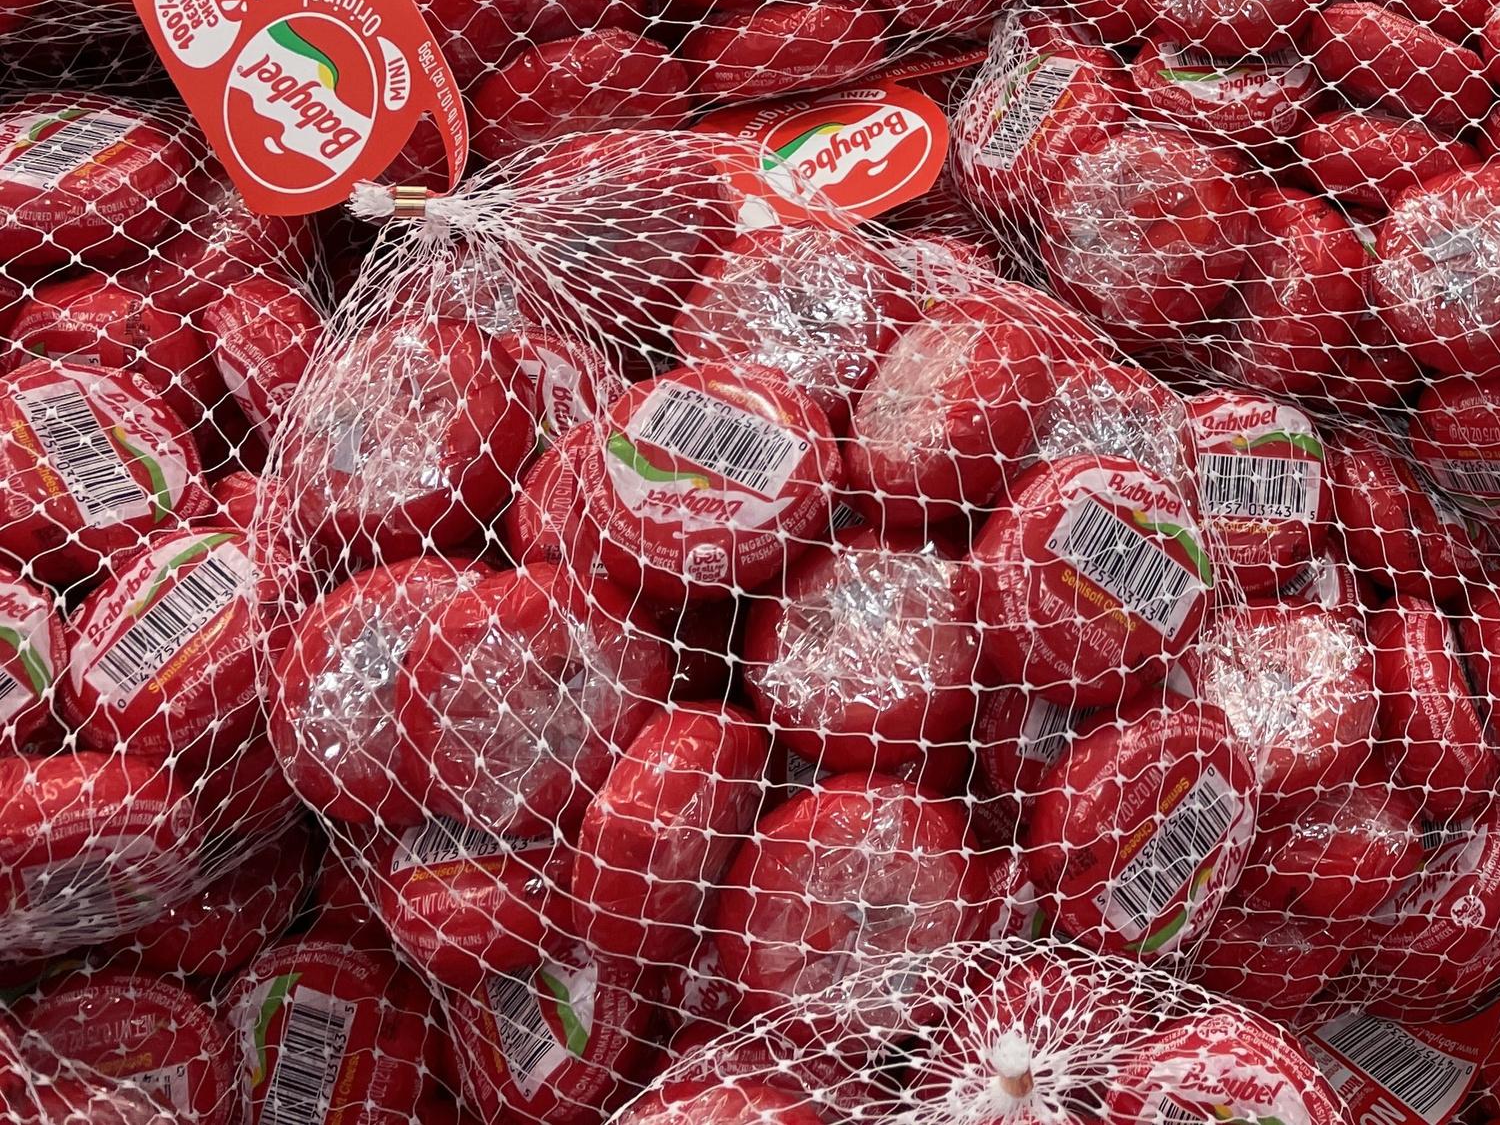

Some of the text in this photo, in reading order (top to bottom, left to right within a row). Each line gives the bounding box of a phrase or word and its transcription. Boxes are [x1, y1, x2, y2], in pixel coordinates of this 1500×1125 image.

[418, 40, 438, 74] 756g
[386, 57, 406, 101] MINI
[429, 67, 445, 88] oz)
[241, 53, 362, 159] Babybel
[437, 87, 454, 111] 10.7
[840, 90, 879, 99] MINI
[448, 107, 458, 125] lb
[1202, 406, 1277, 439] Babybel
[798, 441, 808, 451] 0
[1108, 473, 1182, 518] Babybel
[1248, 503, 1315, 520] 03143 5
[1049, 539, 1057, 550] 0
[1078, 558, 1113, 588] 1757
[1167, 627, 1175, 638] 5
[1061, 570, 1105, 606] Semisoft
[148, 646, 196, 693] Semisoft
[117, 698, 126, 709] 0
[1207, 766, 1216, 777] 0
[393, 839, 528, 871] 0 0343
[1119, 822, 1153, 859] Cheese
[1097, 896, 1106, 906] 5
[326, 1033, 347, 1083] 03143
[1465, 1066, 1473, 1075] 0
